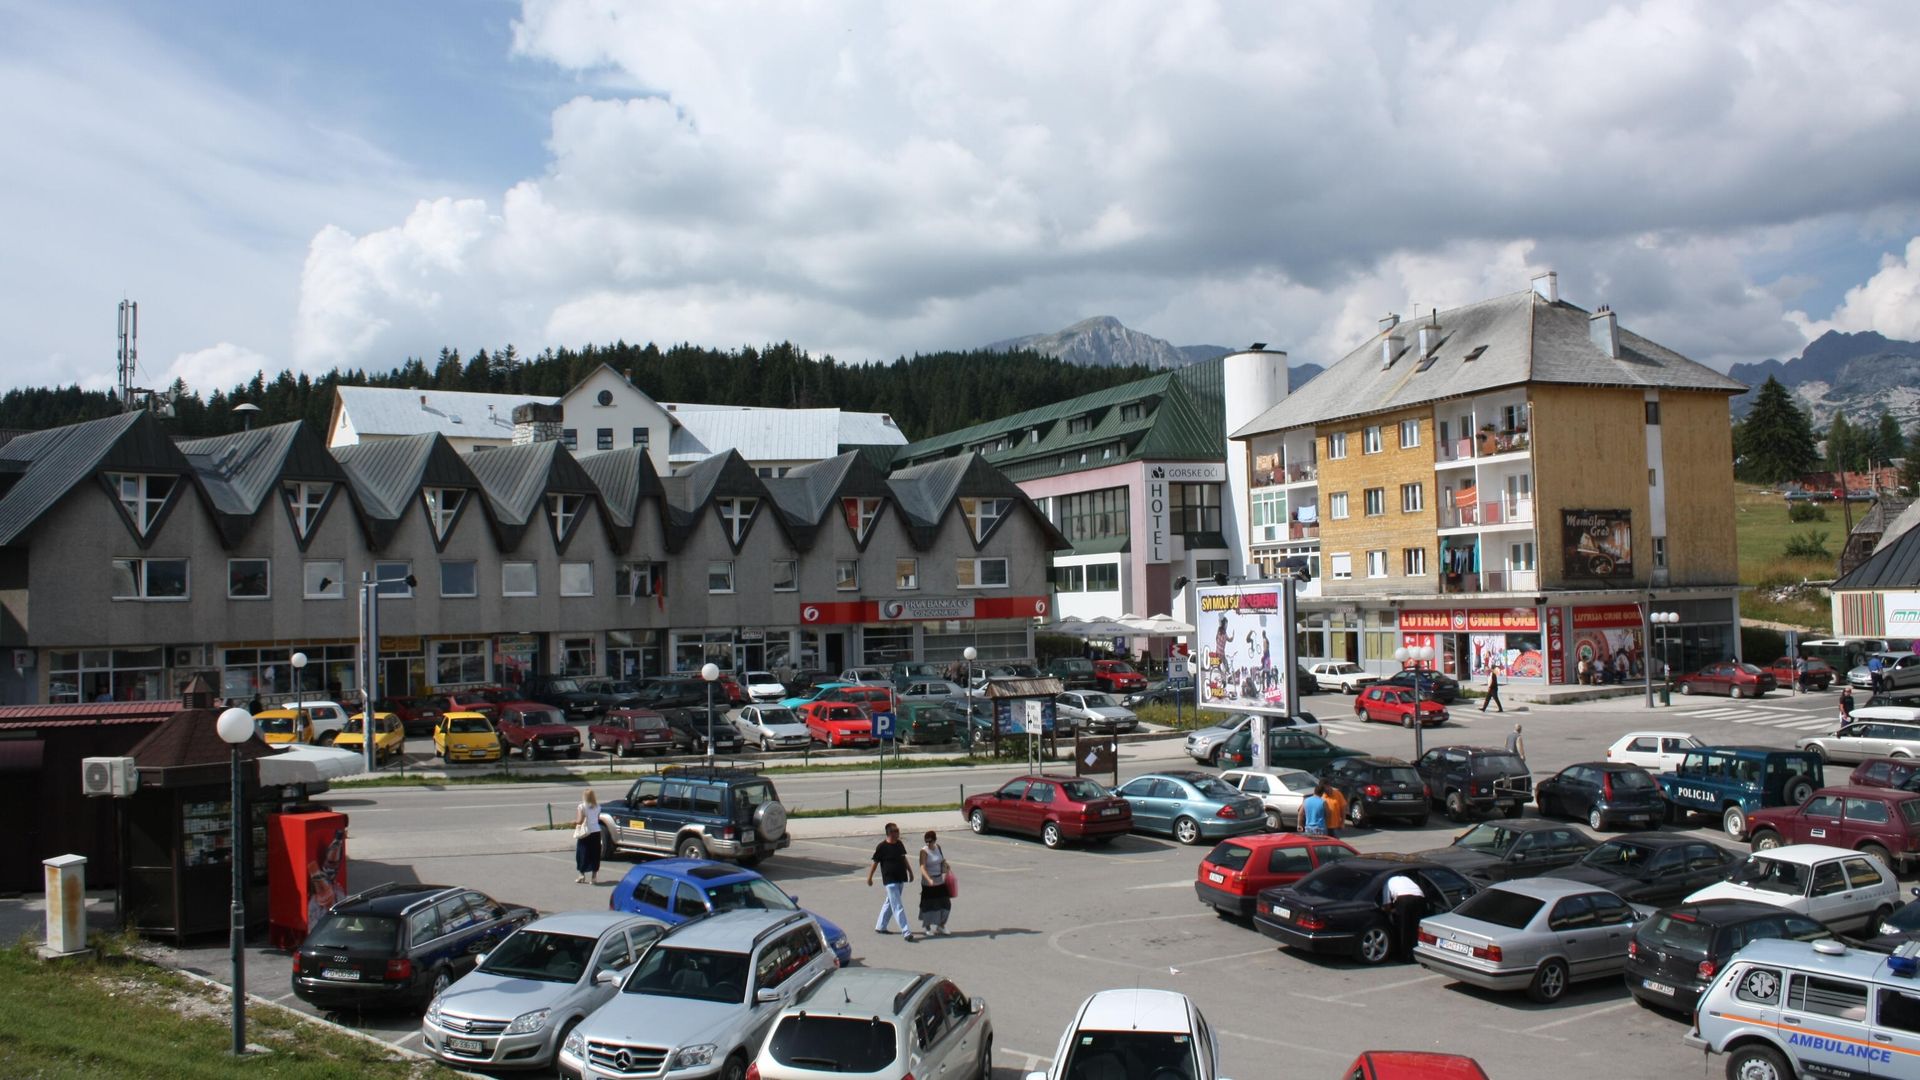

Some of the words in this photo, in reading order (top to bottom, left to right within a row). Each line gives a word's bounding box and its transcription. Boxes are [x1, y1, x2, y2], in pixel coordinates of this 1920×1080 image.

[1168, 468, 1202, 478] GORSKE
[1151, 484, 1163, 560] HOTEL
[904, 599, 925, 609] PRVA
[927, 599, 956, 608] BANKA
[1201, 596, 1213, 611] SVI
[1213, 596, 1229, 611] MOJI
[1229, 594, 1240, 610] SU
[1401, 613, 1449, 627] LUTRIJA
[1469, 613, 1501, 627] CRNE
[1502, 612, 1537, 627] GORE
[1574, 613, 1603, 622] LUTRIJA
[1603, 612, 1622, 620] CRNE
[876, 715, 890, 735] P
[1678, 786, 1716, 803] POLICIJA
[1788, 1032, 1892, 1063] AMBULANCE
